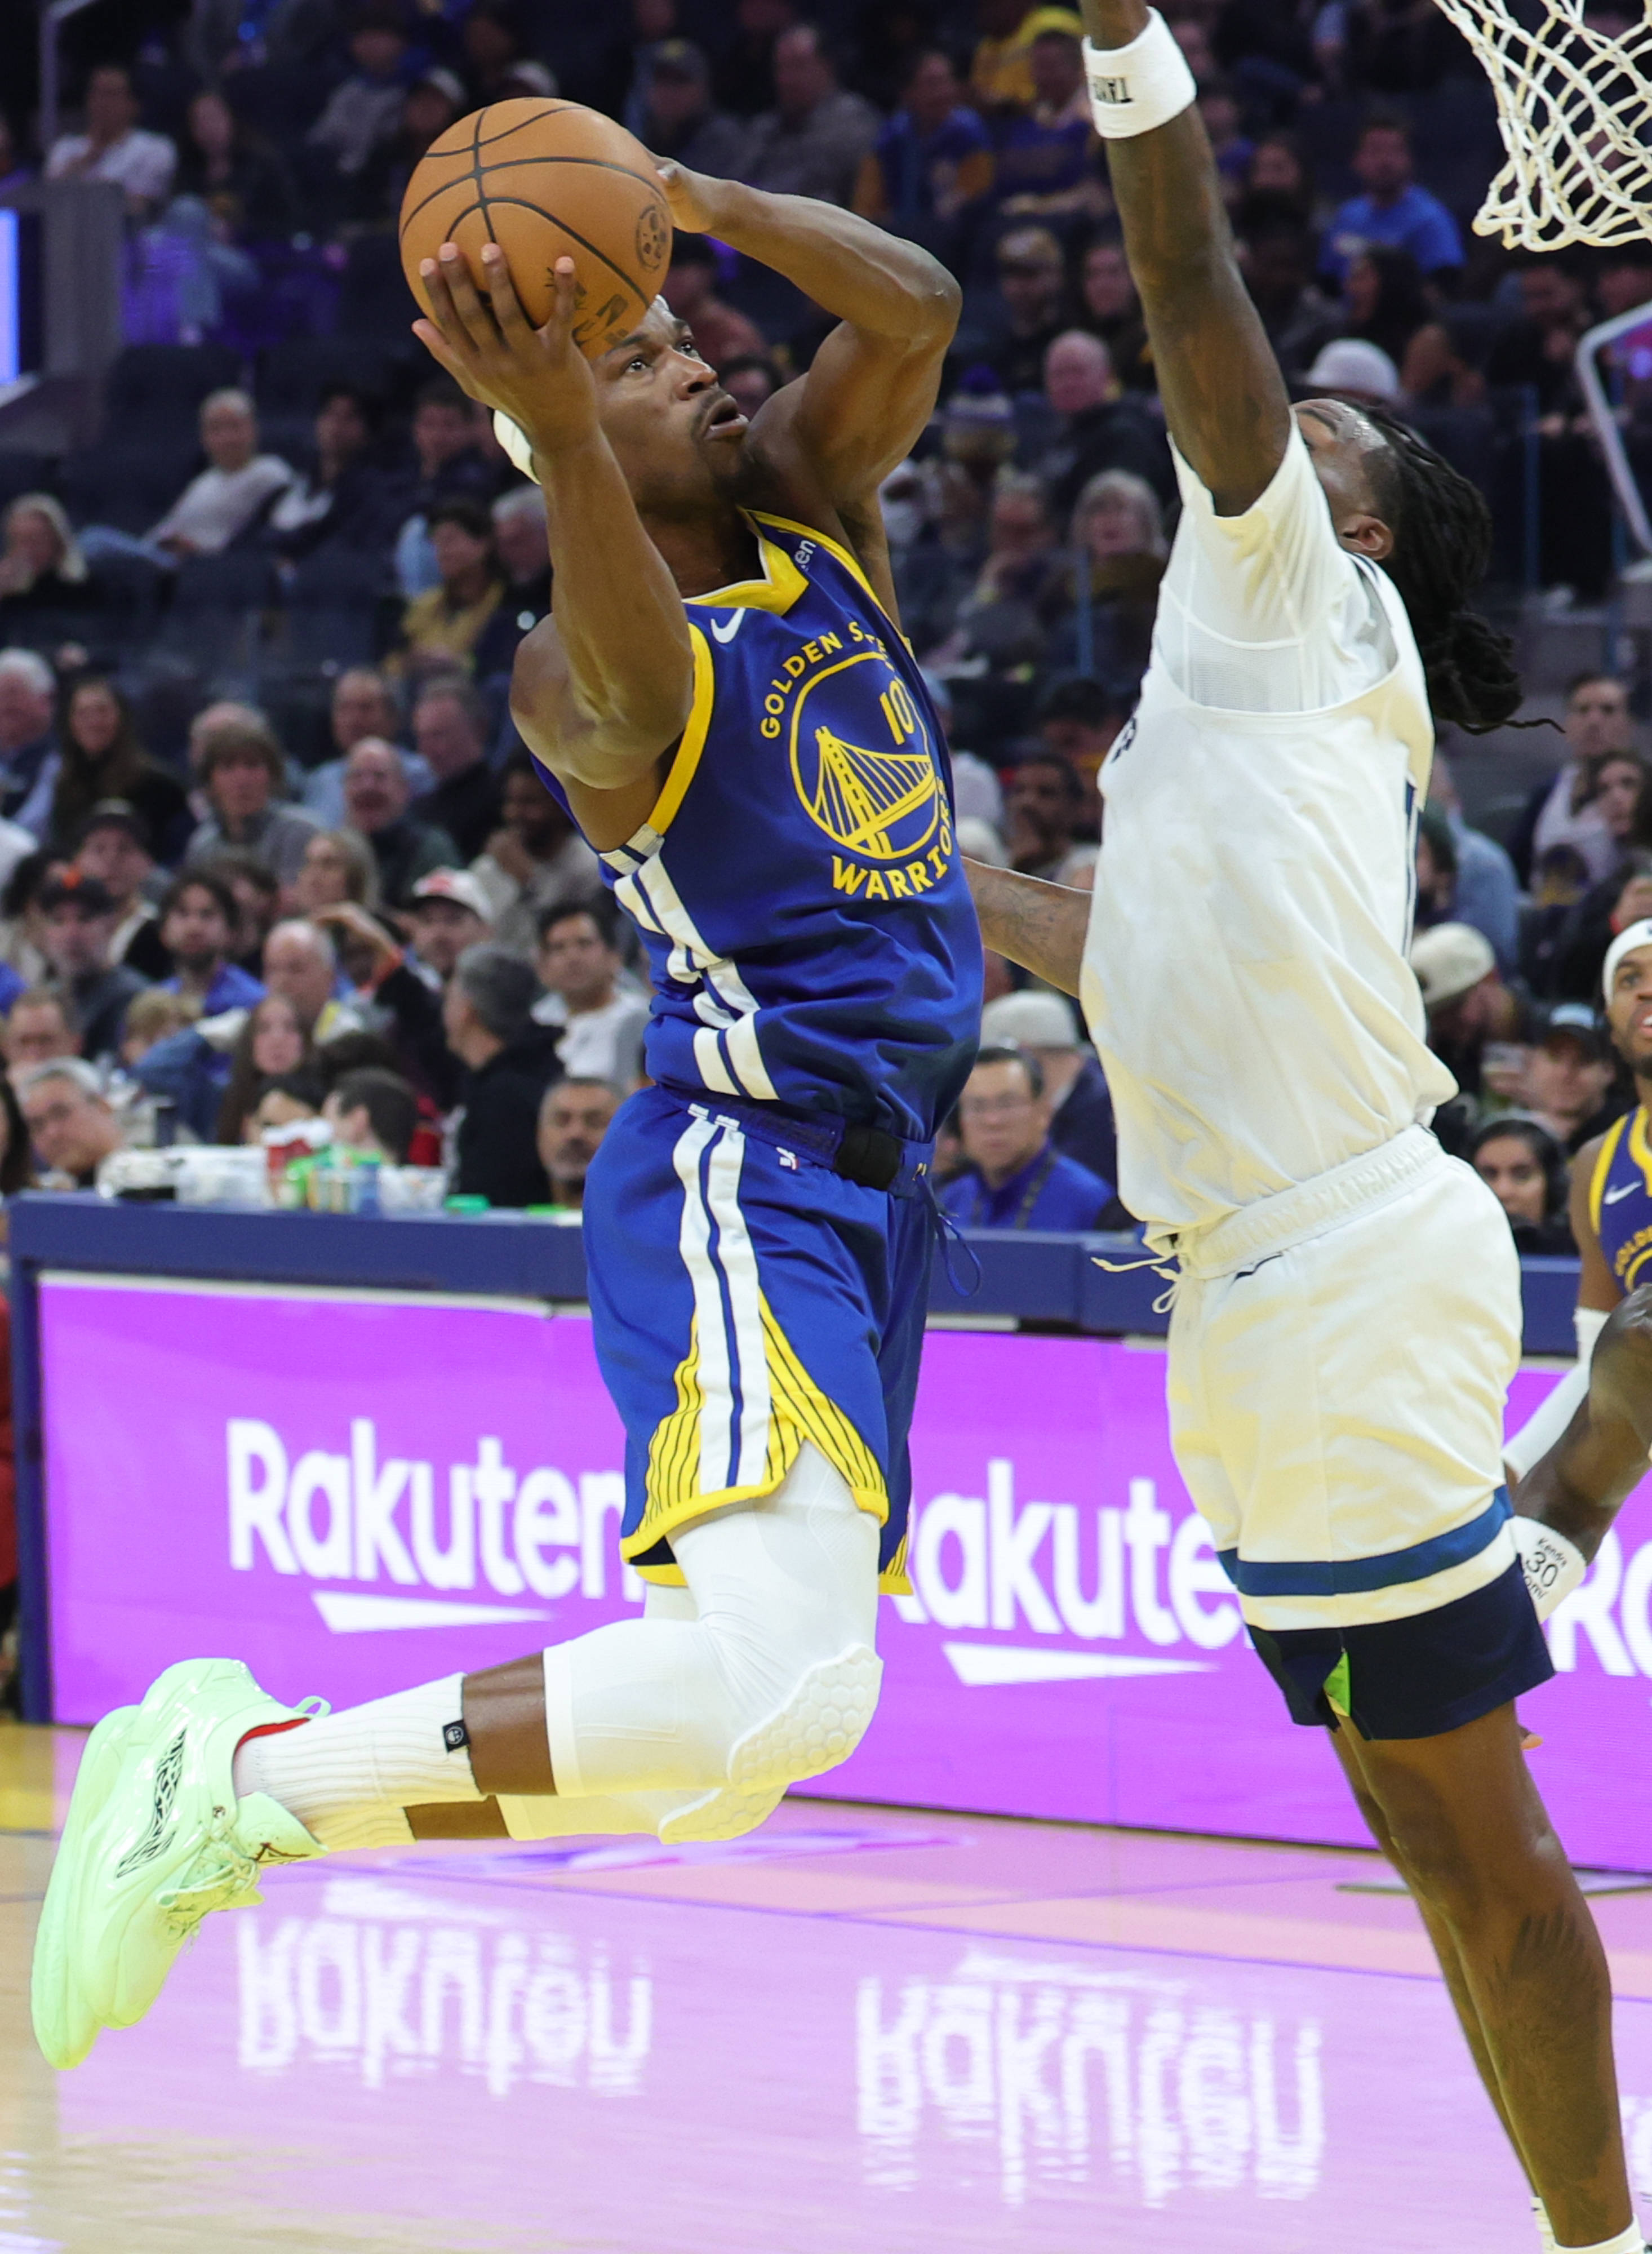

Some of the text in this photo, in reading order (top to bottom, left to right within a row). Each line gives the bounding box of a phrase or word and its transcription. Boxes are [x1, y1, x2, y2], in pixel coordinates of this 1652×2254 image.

[760, 632, 843, 739] GOLDEN
[880, 680, 915, 744] 10
[227, 1417, 646, 1602] Rakuten
[890, 1458, 1255, 1650] akute
[1525, 1551, 1559, 1587] 30
